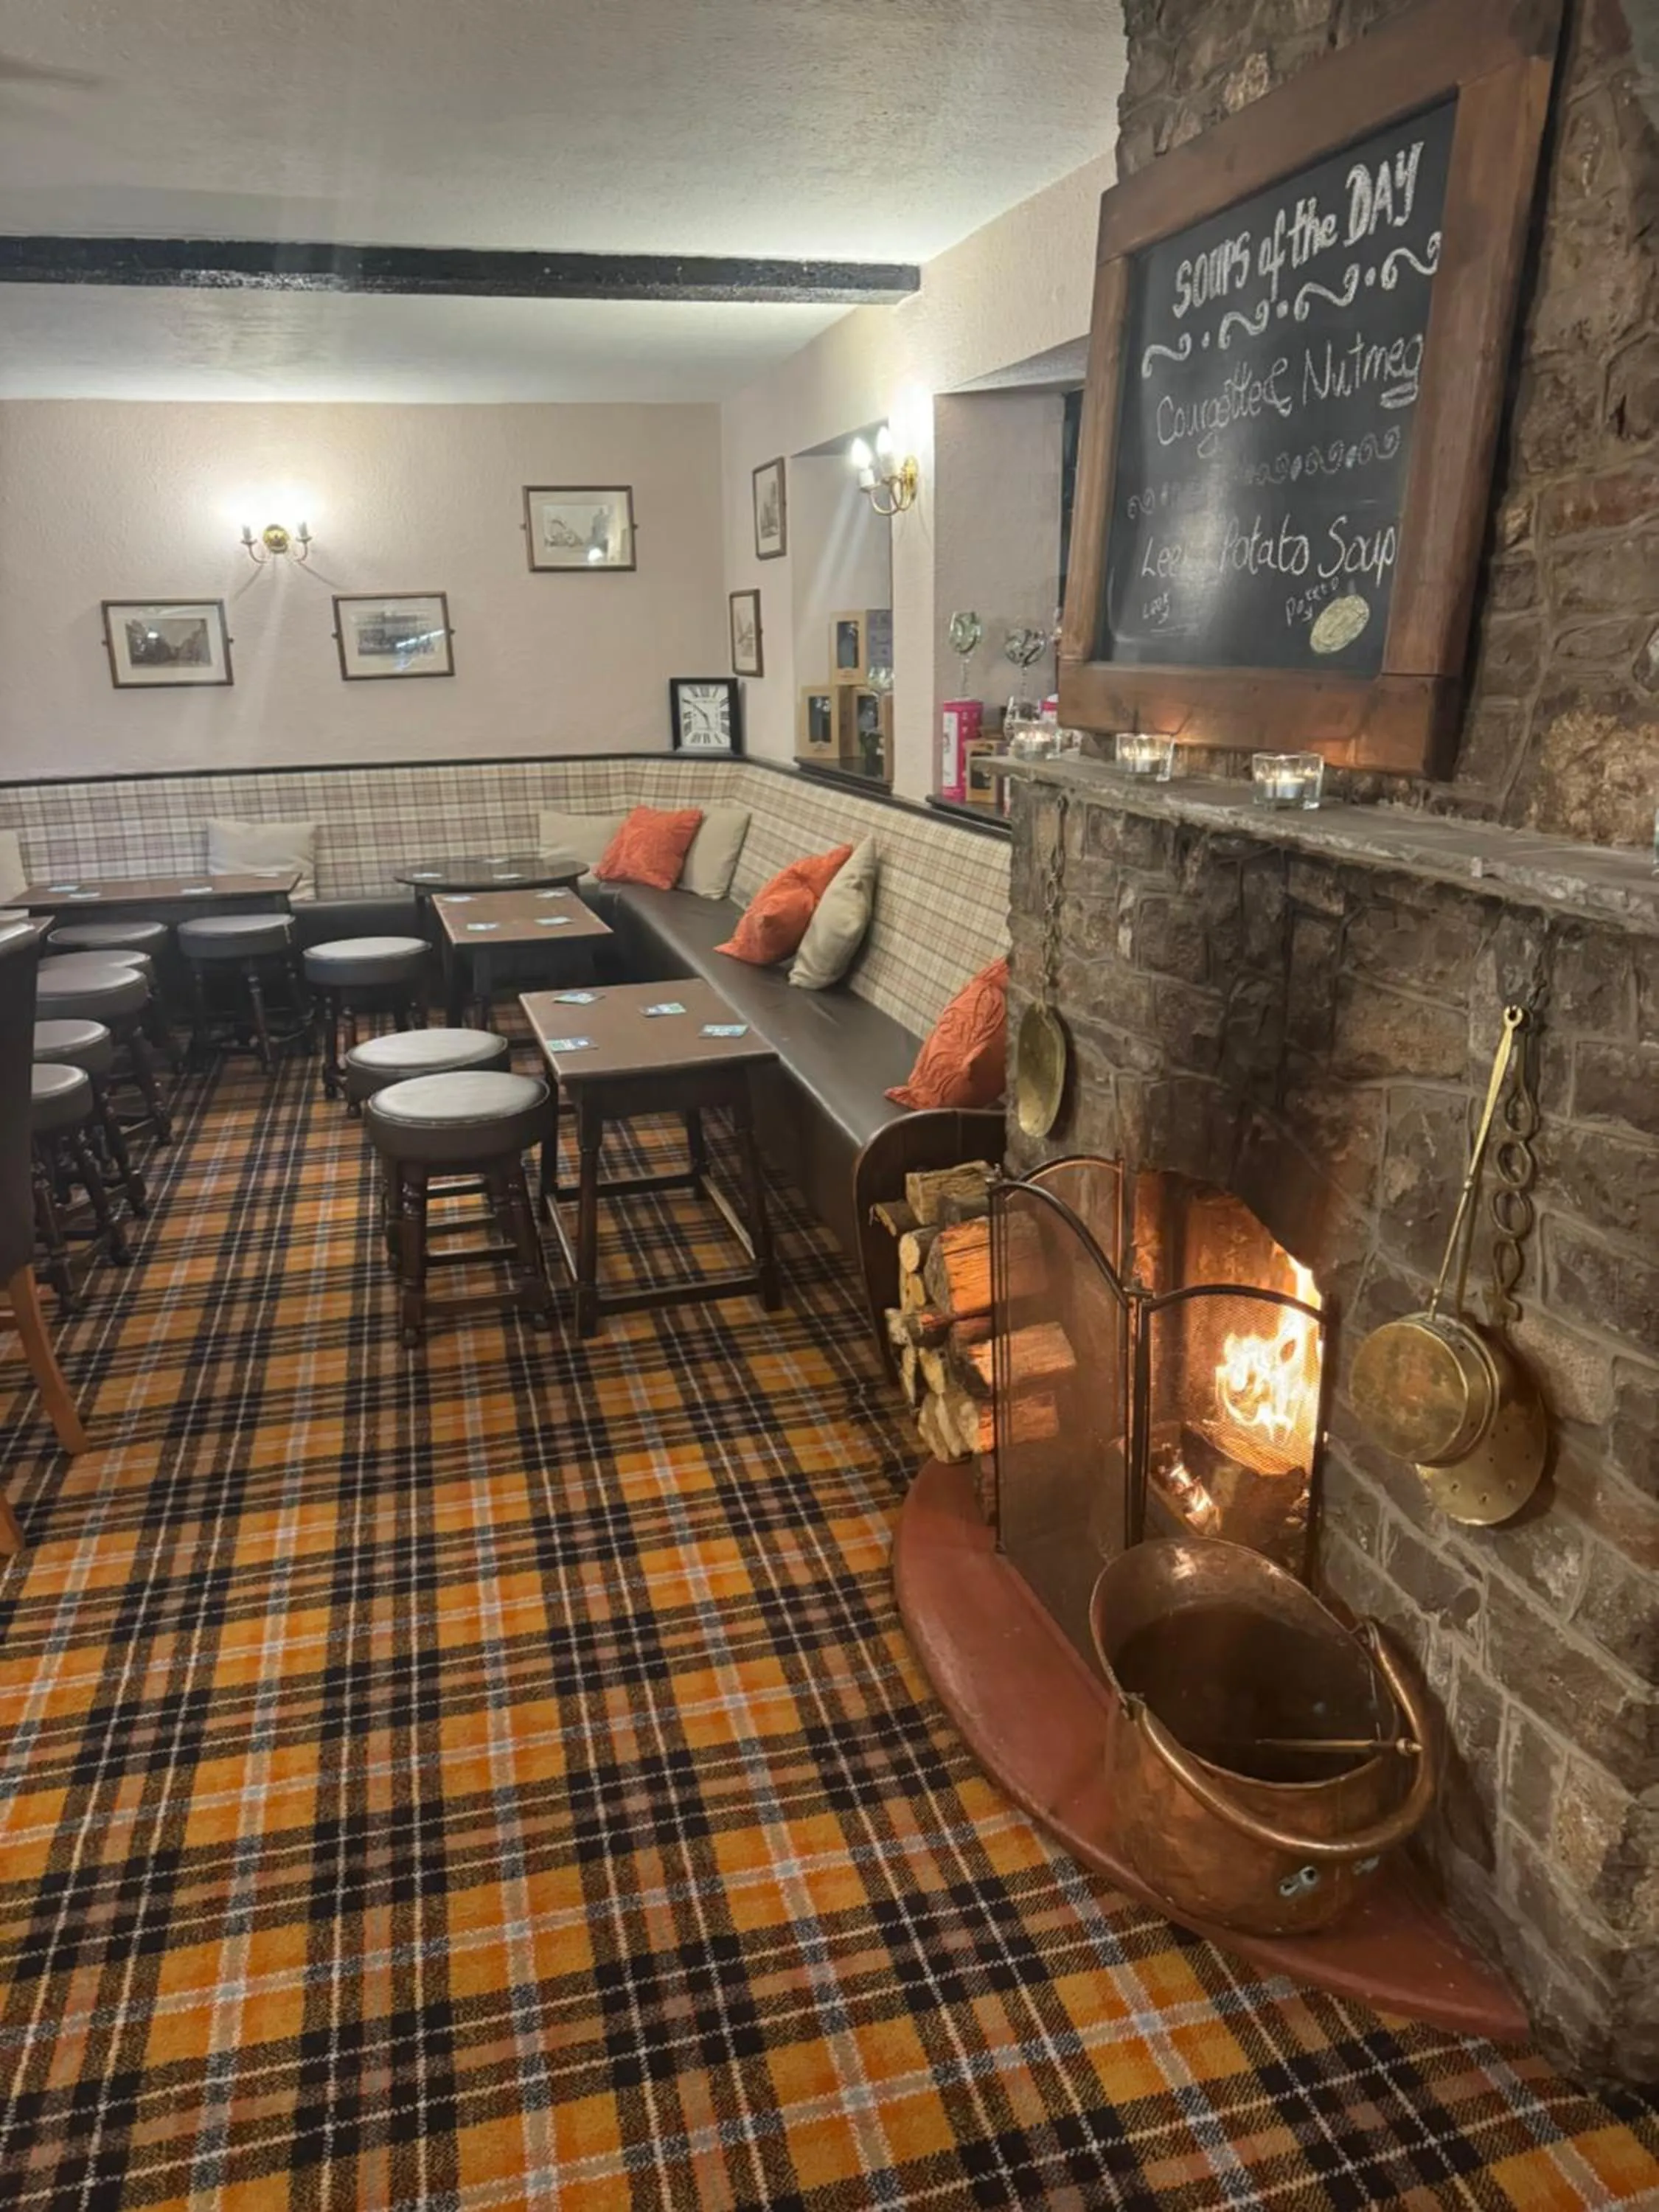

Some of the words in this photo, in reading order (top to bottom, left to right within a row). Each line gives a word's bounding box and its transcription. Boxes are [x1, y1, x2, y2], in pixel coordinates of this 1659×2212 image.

[1258, 209, 1286, 303] of
[1286, 196, 1339, 270] the
[1343, 141, 1425, 248] DAY
[1302, 330, 1424, 409] Nutmeg
[1219, 514, 1310, 575] Potato
[1318, 515, 1397, 588] Soup
